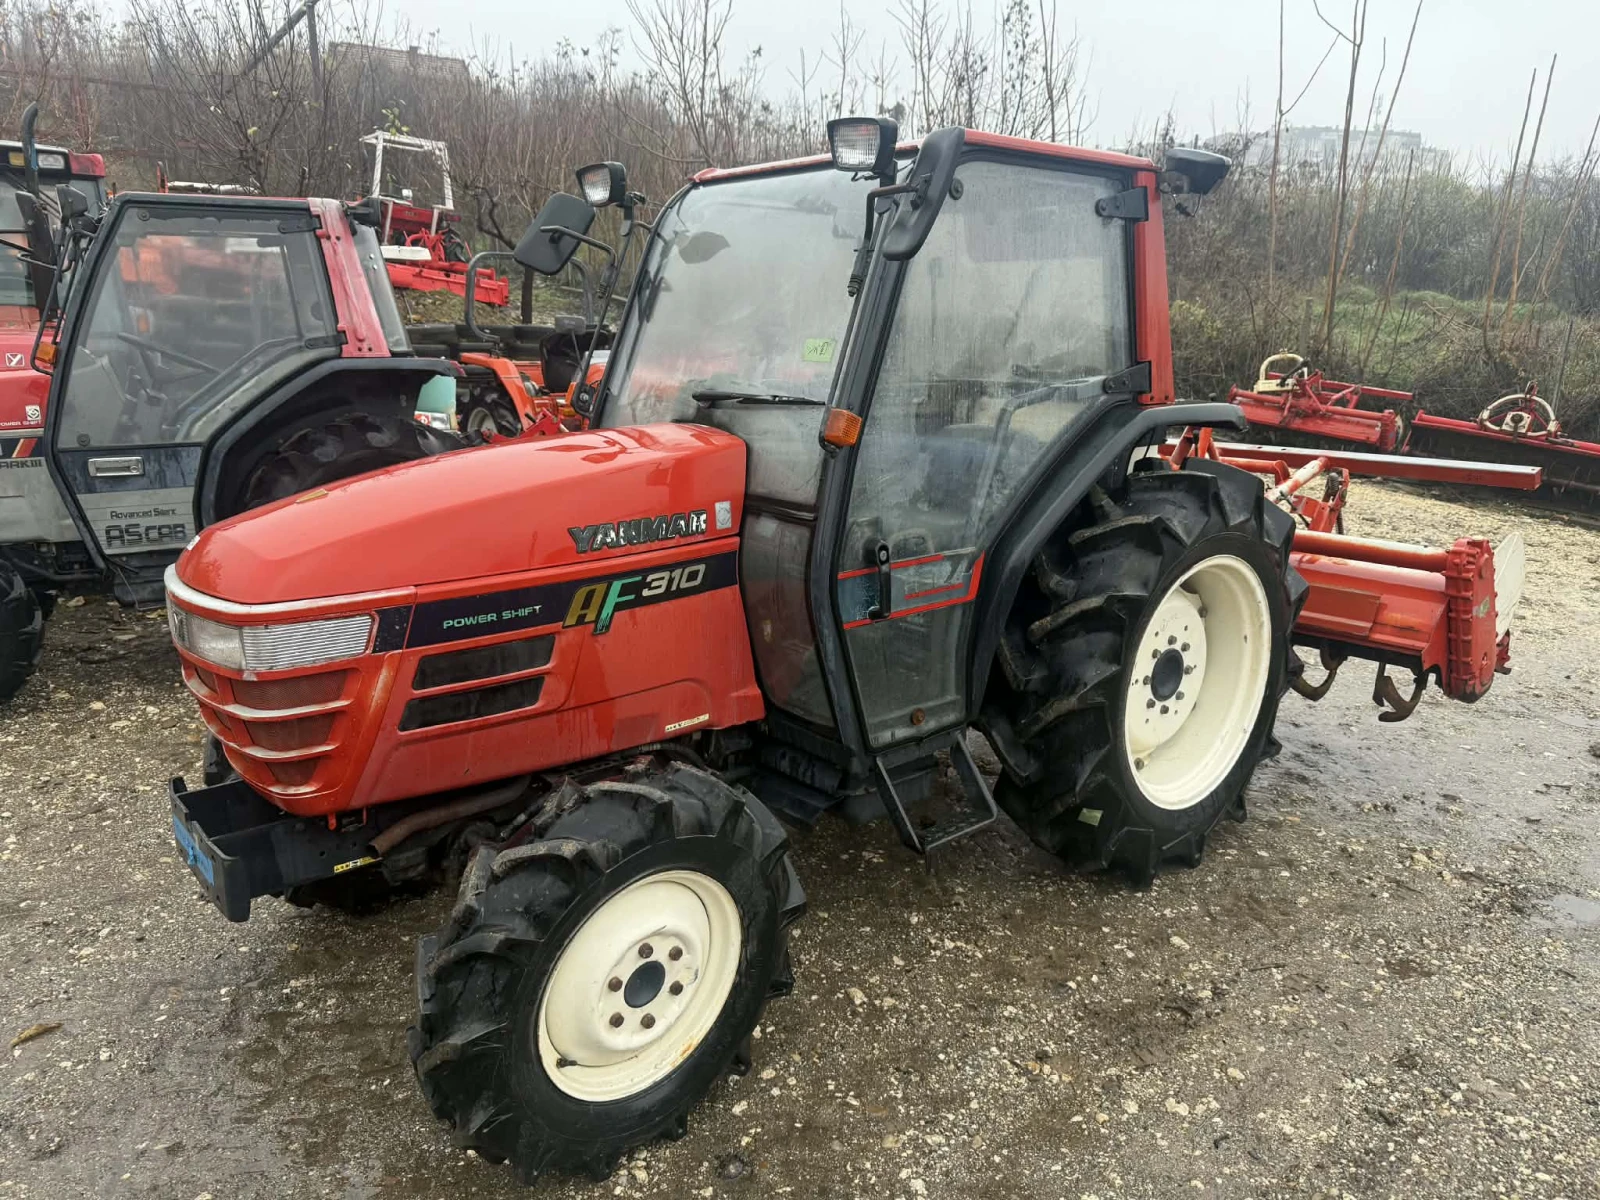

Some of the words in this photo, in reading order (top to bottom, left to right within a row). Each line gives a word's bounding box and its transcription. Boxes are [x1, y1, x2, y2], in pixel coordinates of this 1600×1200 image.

[568, 510, 708, 554] YANMAR
[443, 613, 498, 630] POWER
[501, 605, 542, 620] SHIFT
